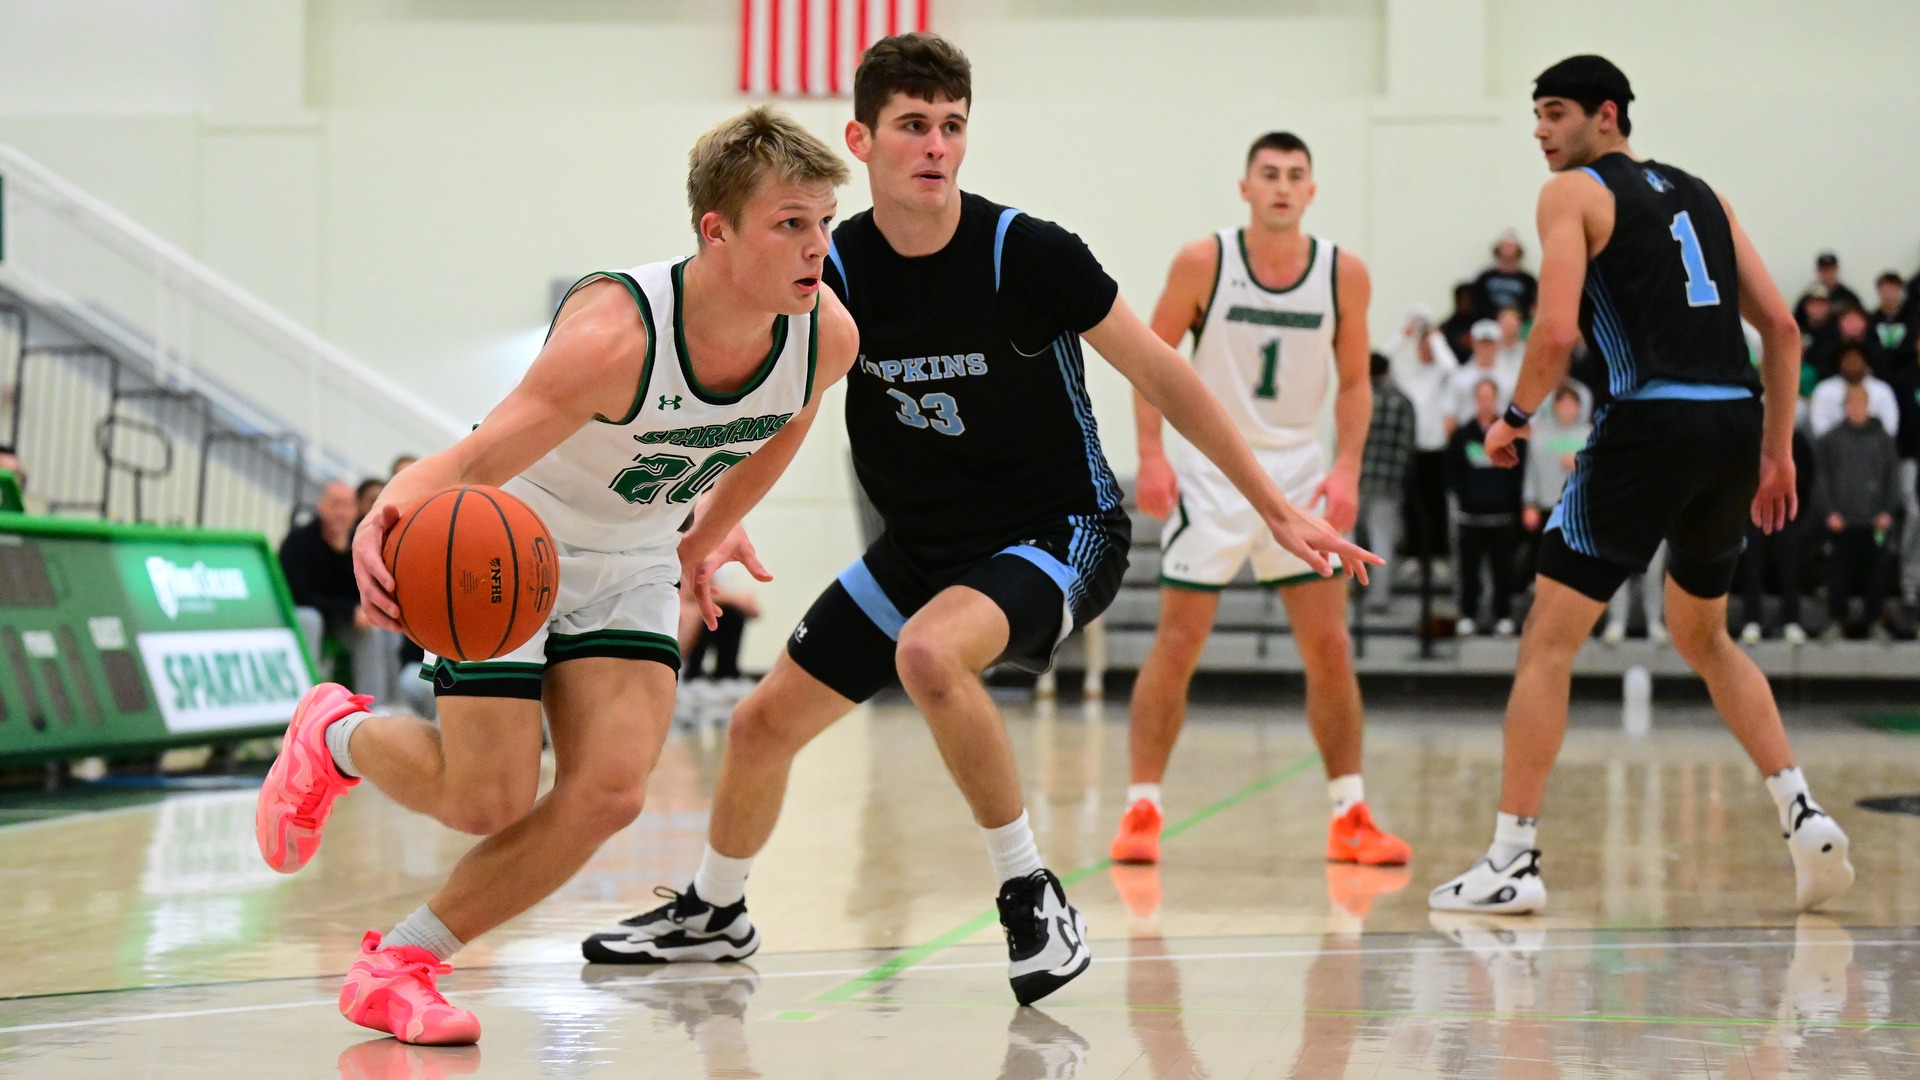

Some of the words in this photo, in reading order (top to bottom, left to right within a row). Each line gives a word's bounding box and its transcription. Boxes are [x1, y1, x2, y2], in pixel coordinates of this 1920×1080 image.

[1669, 210, 1721, 307] 1
[1254, 338, 1280, 399] 1
[633, 412, 794, 448] SPARTANS
[886, 387, 966, 436] 33
[490, 568, 502, 604] NFHS
[163, 650, 299, 713] SPARTANS
